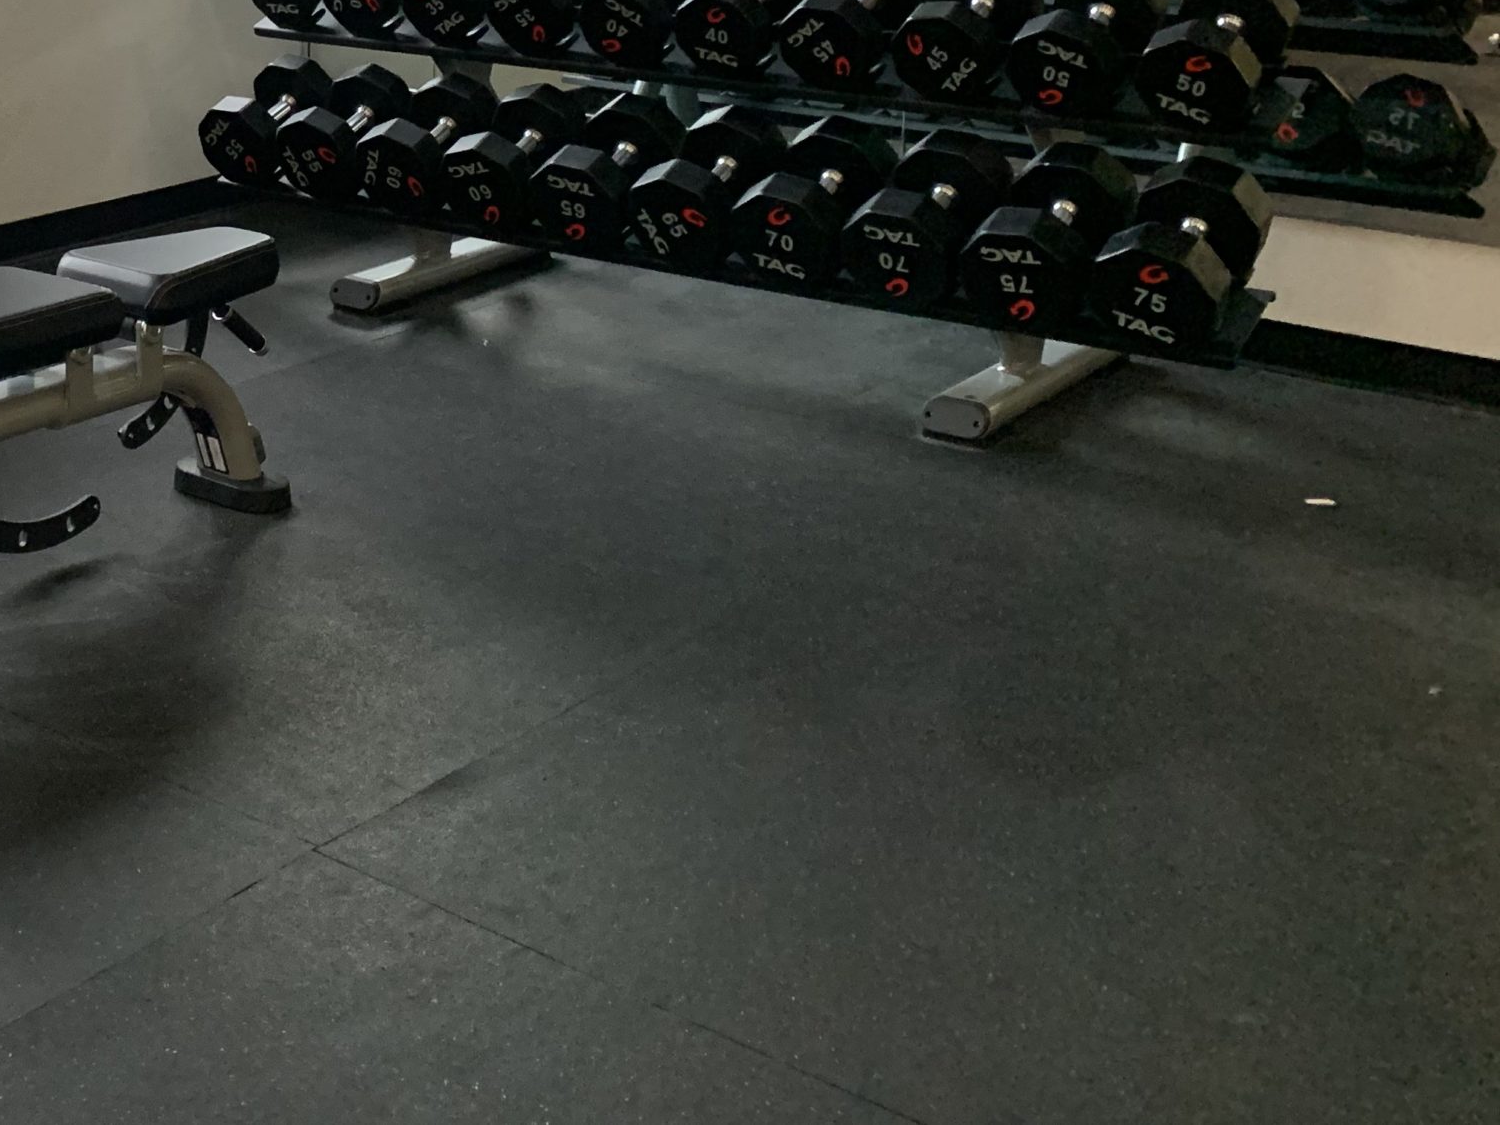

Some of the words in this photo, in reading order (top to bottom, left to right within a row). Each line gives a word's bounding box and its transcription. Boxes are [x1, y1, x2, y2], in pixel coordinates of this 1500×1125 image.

[264, 3, 300, 15] TAG
[515, 8, 535, 28] 35
[433, 11, 465, 36] TAG
[605, 19, 628, 38] 40
[786, 18, 826, 48] TAG
[705, 27, 729, 45] 40
[695, 46, 739, 68] TAG
[812, 39, 835, 64] 45
[926, 45, 949, 71] 45
[1036, 39, 1089, 70] TAG
[940, 57, 978, 92] TAG
[1041, 65, 1070, 89] 50
[1175, 73, 1206, 97] 50
[1155, 92, 1212, 126] TAG
[204, 118, 230, 147] TAG
[224, 138, 244, 160] 55
[301, 149, 324, 173] 55
[282, 145, 310, 188] TAG
[363, 148, 380, 186] TAG
[386, 165, 404, 189] 60
[447, 160, 491, 179] TAG
[468, 183, 492, 202] 60
[546, 173, 596, 197] TAG
[560, 199, 587, 219] 65
[636, 208, 671, 255] TAG
[661, 211, 688, 238] 65
[862, 224, 921, 248] TAG
[764, 229, 794, 252] 70
[752, 252, 807, 281] TAG
[878, 251, 911, 274] 70
[979, 245, 1043, 266] TAG
[999, 274, 1034, 295] 75
[1132, 286, 1168, 314] 75
[1111, 309, 1177, 345] TAG
